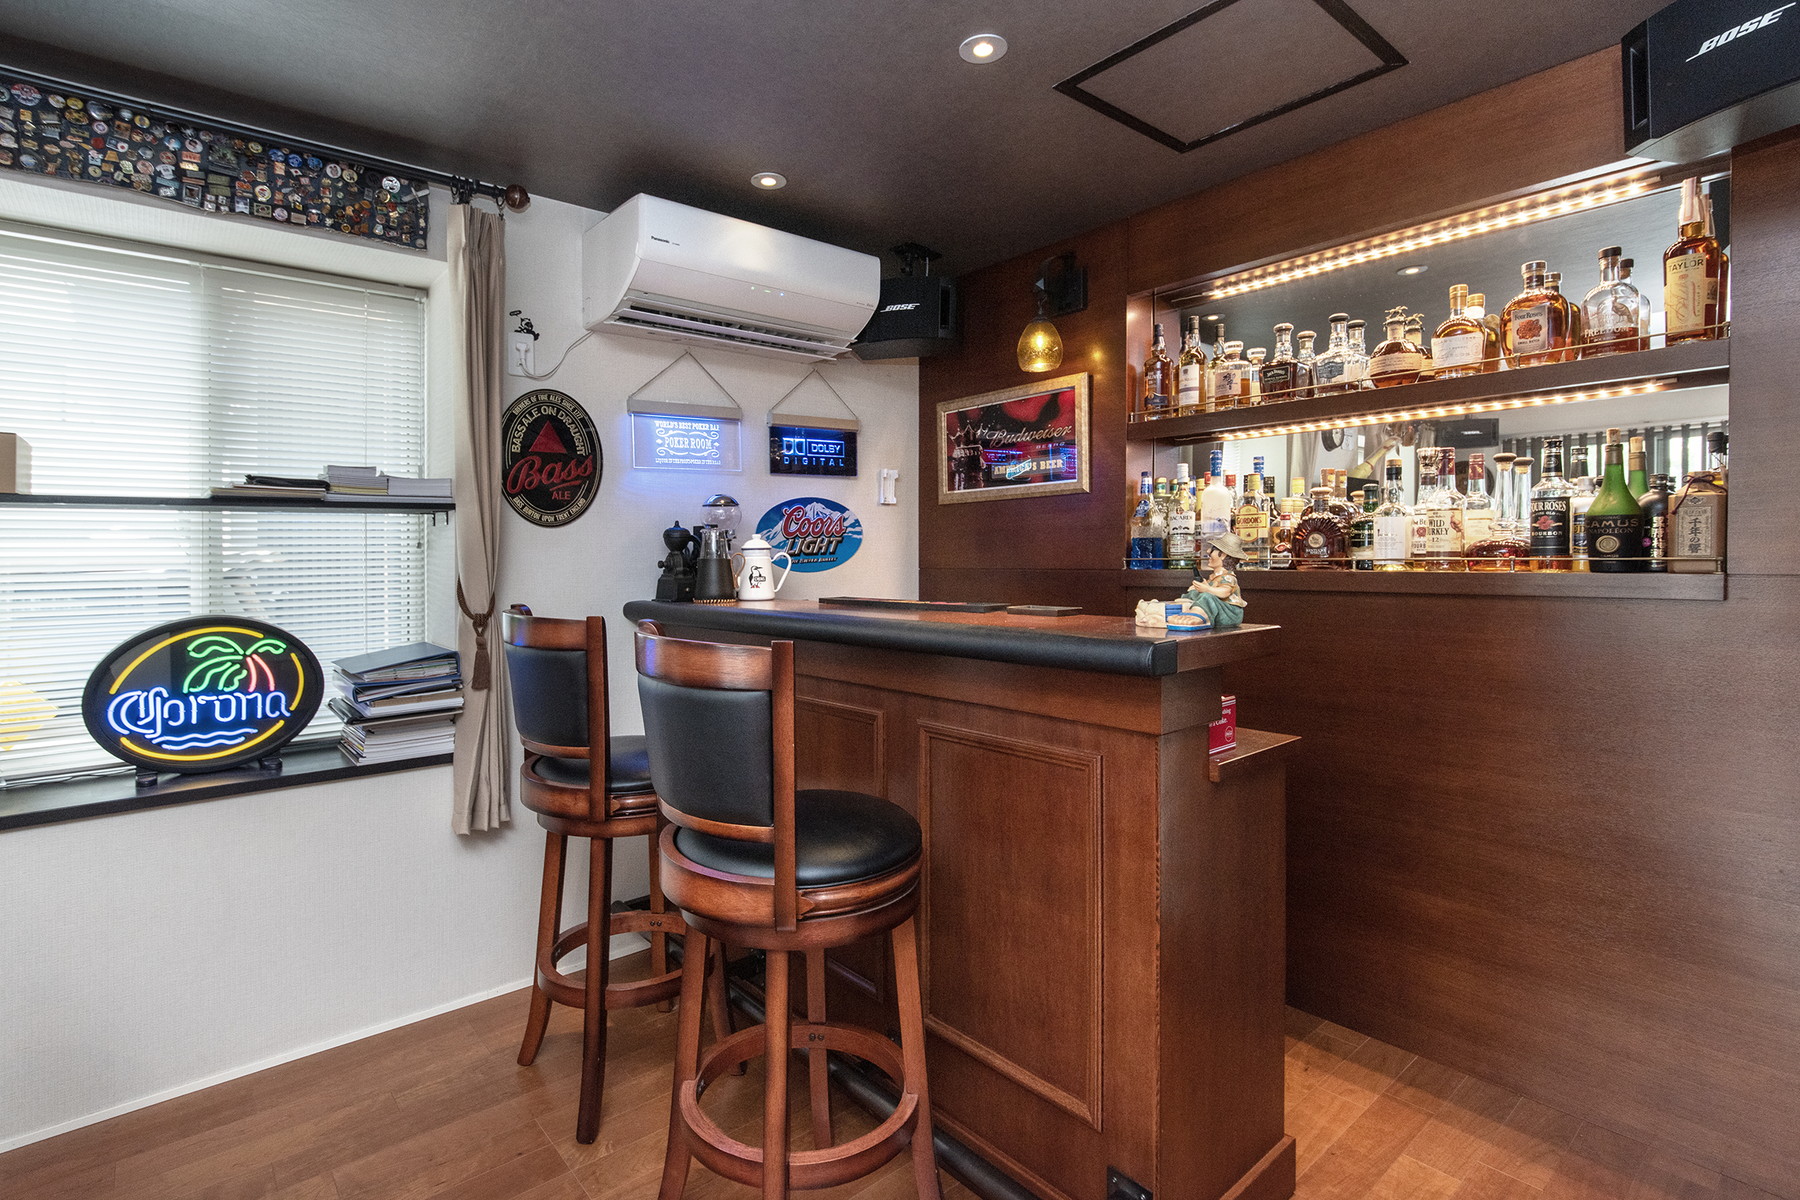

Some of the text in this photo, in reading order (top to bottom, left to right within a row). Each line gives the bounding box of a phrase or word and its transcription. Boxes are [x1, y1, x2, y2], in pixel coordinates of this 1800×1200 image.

[1686, 2, 1796, 62] BOSE
[651, 235, 670, 244] Panasonic
[1668, 259, 1704, 273] TAYLOR
[880, 303, 920, 313] BOSE
[1584, 326, 1629, 338] FREEDOM
[530, 395, 537, 403] OF
[511, 405, 586, 456] BASS ALE ON DRAUGHT
[678, 422, 692, 430] BEST
[692, 423, 710, 431] POKER
[986, 424, 1072, 449] Budweiser
[664, 437, 712, 450] POKER ROOM
[811, 443, 840, 453] DOLBY
[784, 456, 844, 466] DIGITAL
[1040, 459, 1063, 471] BEER
[507, 455, 593, 494] Bass
[552, 491, 571, 500] ALE
[1544, 501, 1567, 512] ROSES
[541, 514, 555, 522] UPON
[556, 511, 570, 521] TRENT
[783, 505, 847, 538] Coors
[1428, 519, 1445, 527] WILD
[785, 537, 843, 556] LIGHT
[107, 687, 291, 738] Corona
